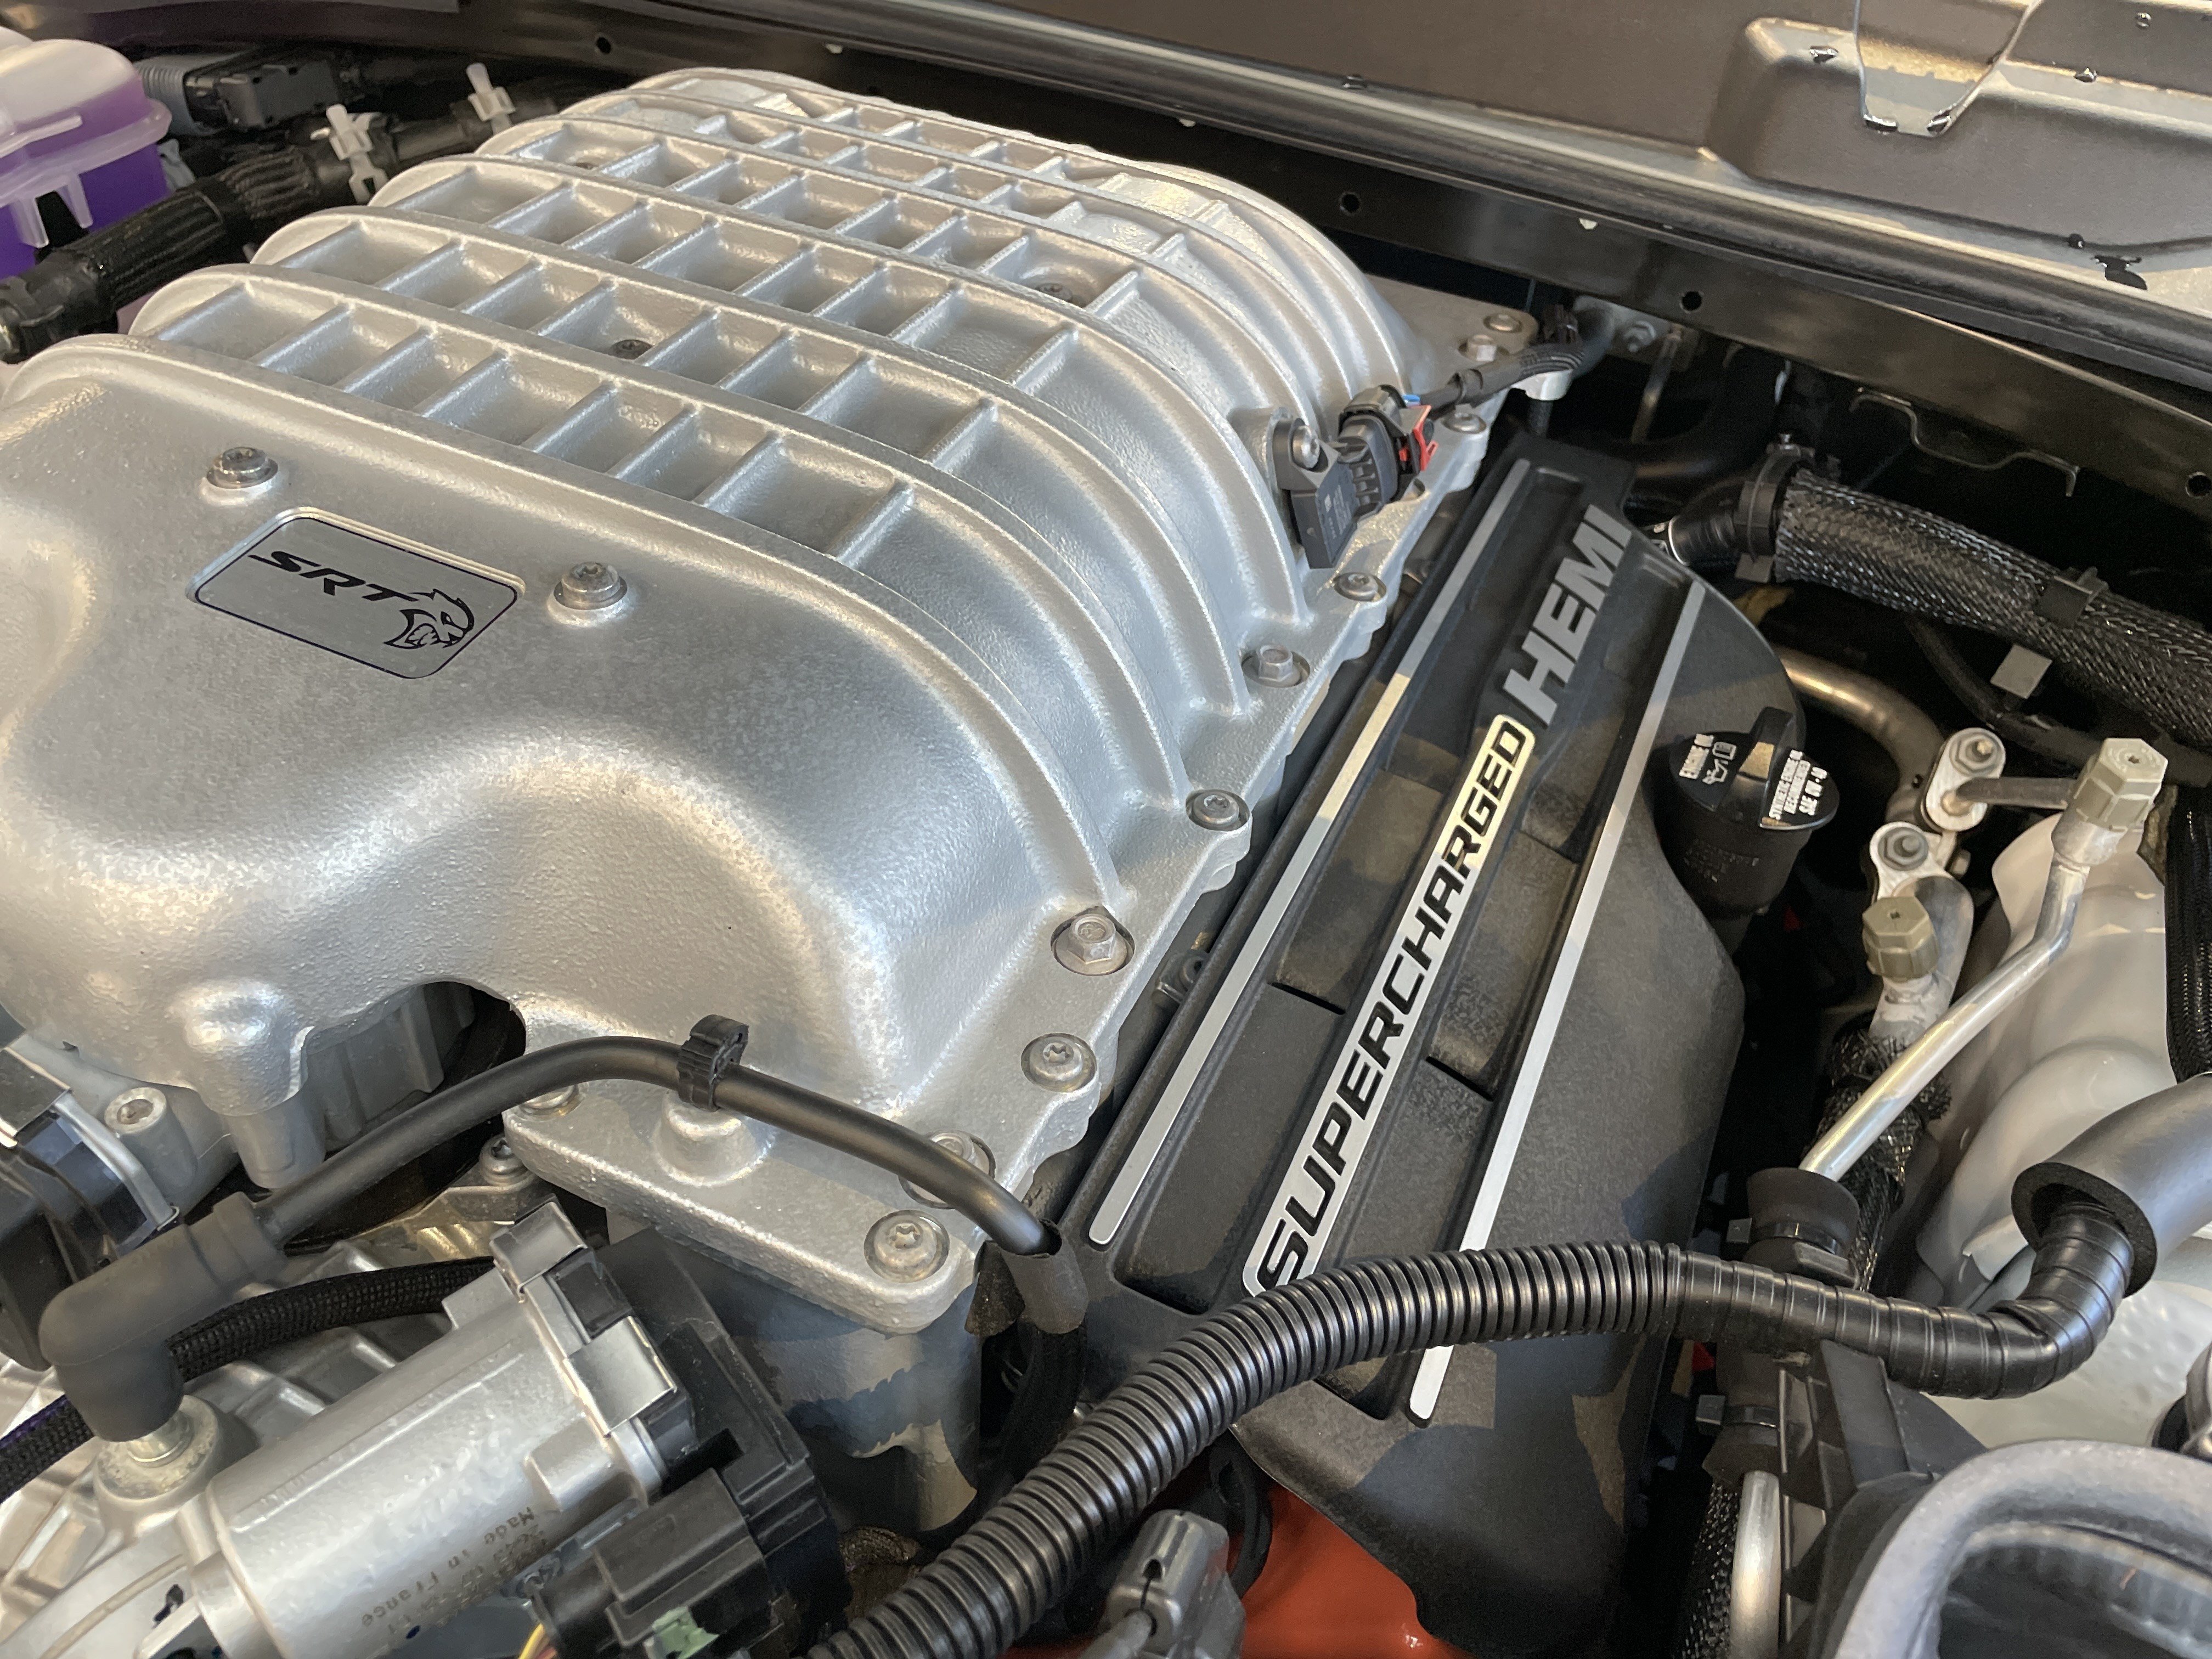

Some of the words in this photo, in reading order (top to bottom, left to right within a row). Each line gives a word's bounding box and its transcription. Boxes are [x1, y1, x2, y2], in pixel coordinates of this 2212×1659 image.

[247, 550, 419, 602] SRT
[1503, 504, 1633, 726] HEMI
[1257, 720, 1527, 1291] SUPERCHARGED
[483, 1506, 535, 1545] Made
[361, 1571, 439, 1628] France
